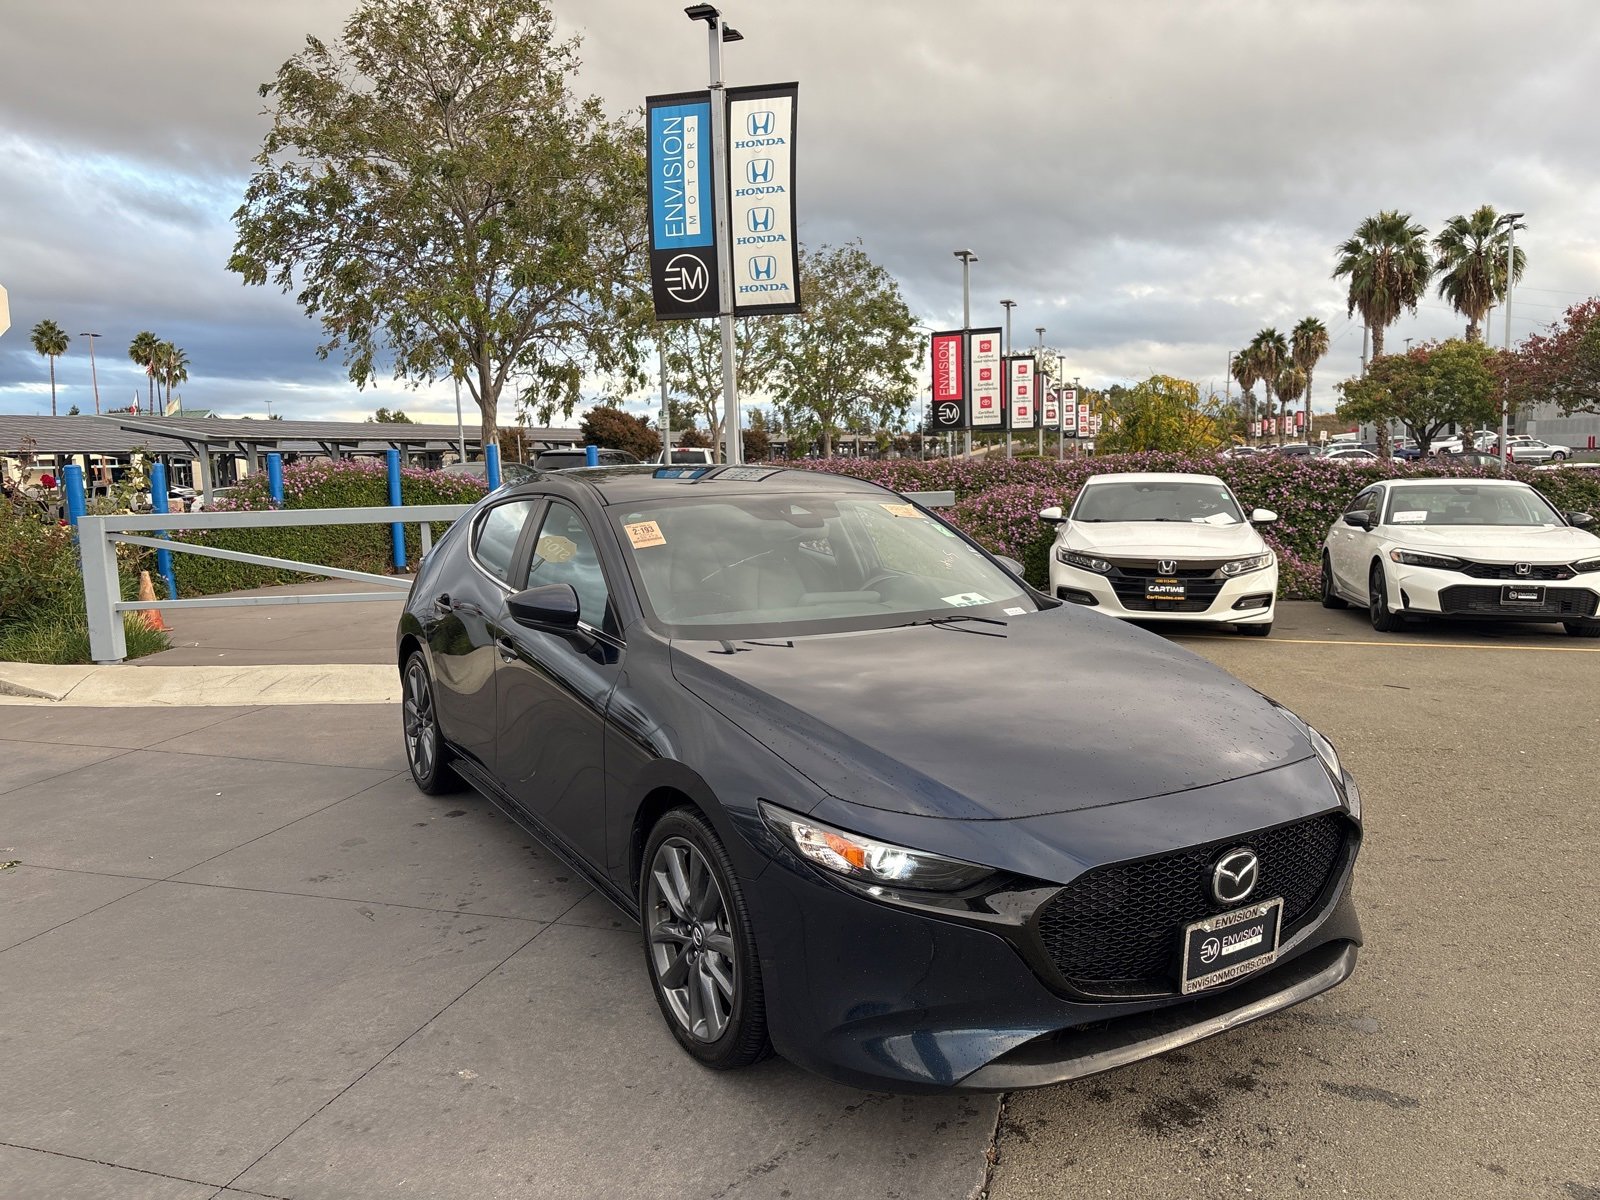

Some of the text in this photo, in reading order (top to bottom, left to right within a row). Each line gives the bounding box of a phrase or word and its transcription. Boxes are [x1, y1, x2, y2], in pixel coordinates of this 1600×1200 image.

[735, 137, 786, 149] HONDA
[663, 117, 685, 237] ENVISION
[687, 126, 697, 225] MOTORS
[735, 185, 786, 197] HONDA
[736, 234, 787, 245] HONDA
[739, 282, 790, 293] HONDA
[938, 341, 949, 396] ENVISION
[1215, 907, 1258, 928] ENVISION
[1222, 924, 1264, 947] ENVISION
[1187, 954, 1274, 992] ENVISIONMOTORS.COM
